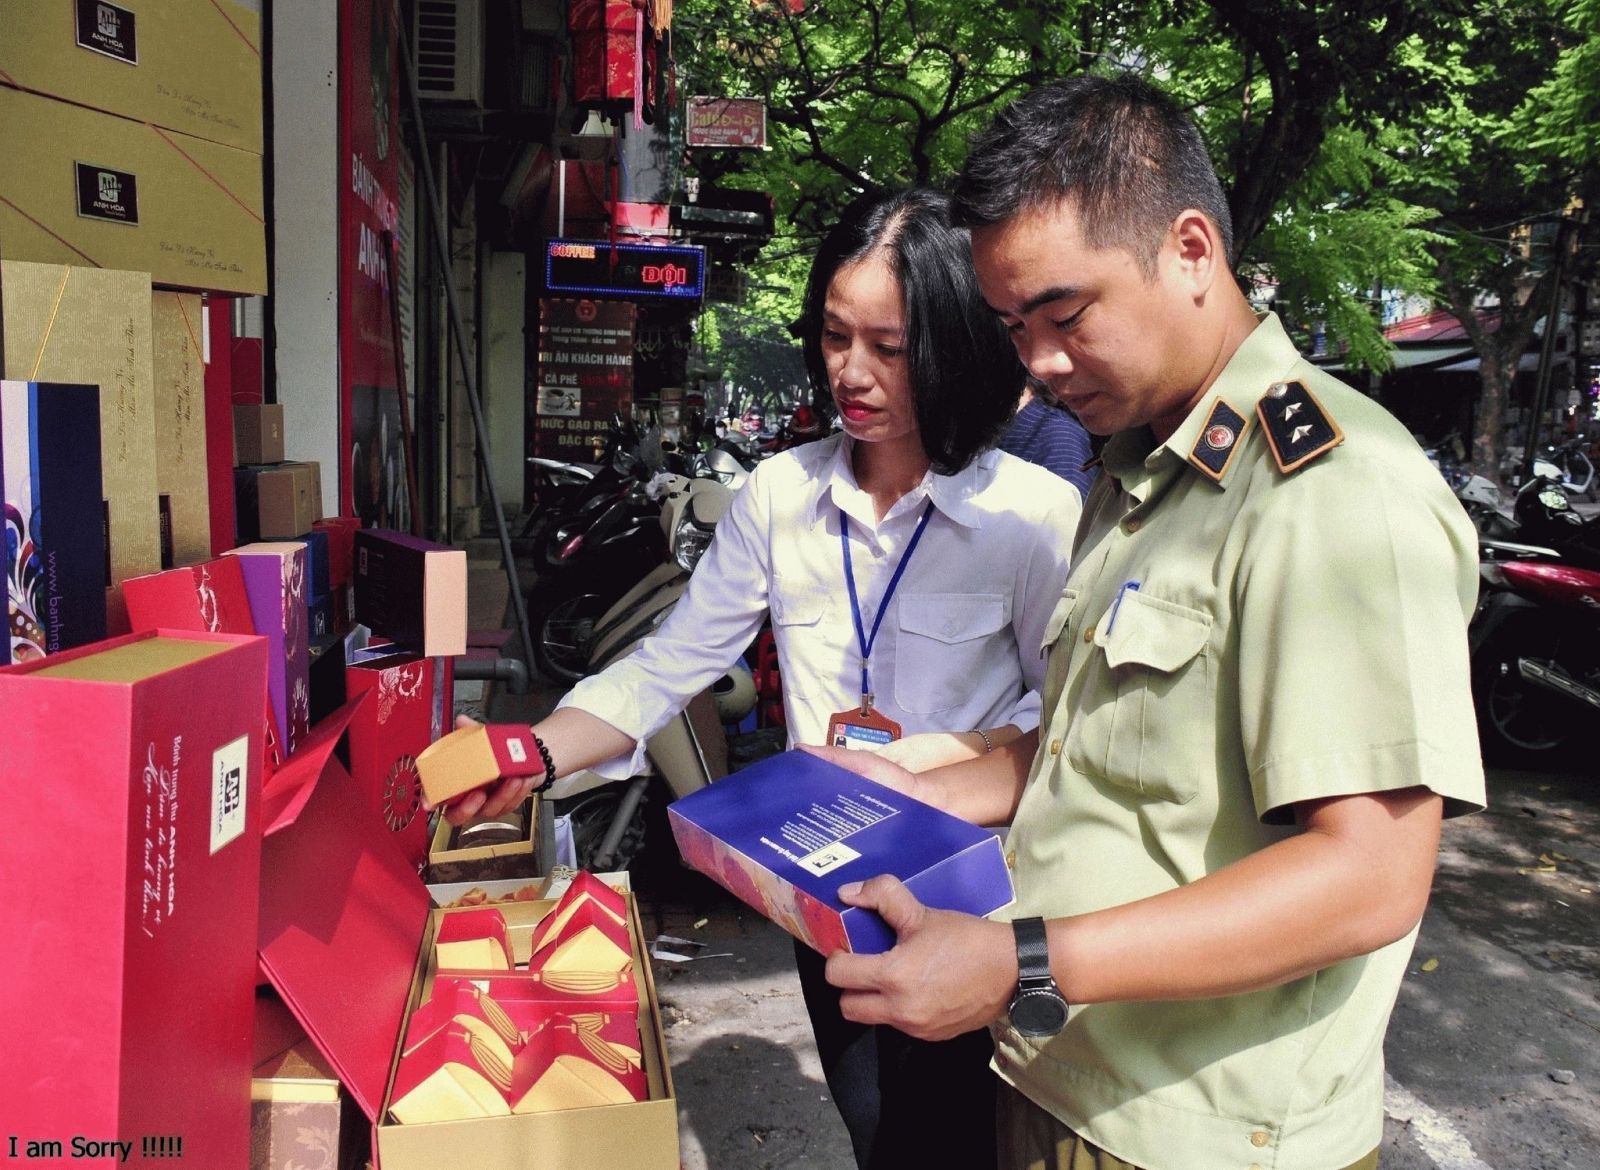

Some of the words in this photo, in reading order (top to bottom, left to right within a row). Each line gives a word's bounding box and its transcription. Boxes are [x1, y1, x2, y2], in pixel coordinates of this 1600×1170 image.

[571, 352, 603, 365] KHÁCH
[170, 769, 179, 800] trung
[170, 802, 178, 821] thu
